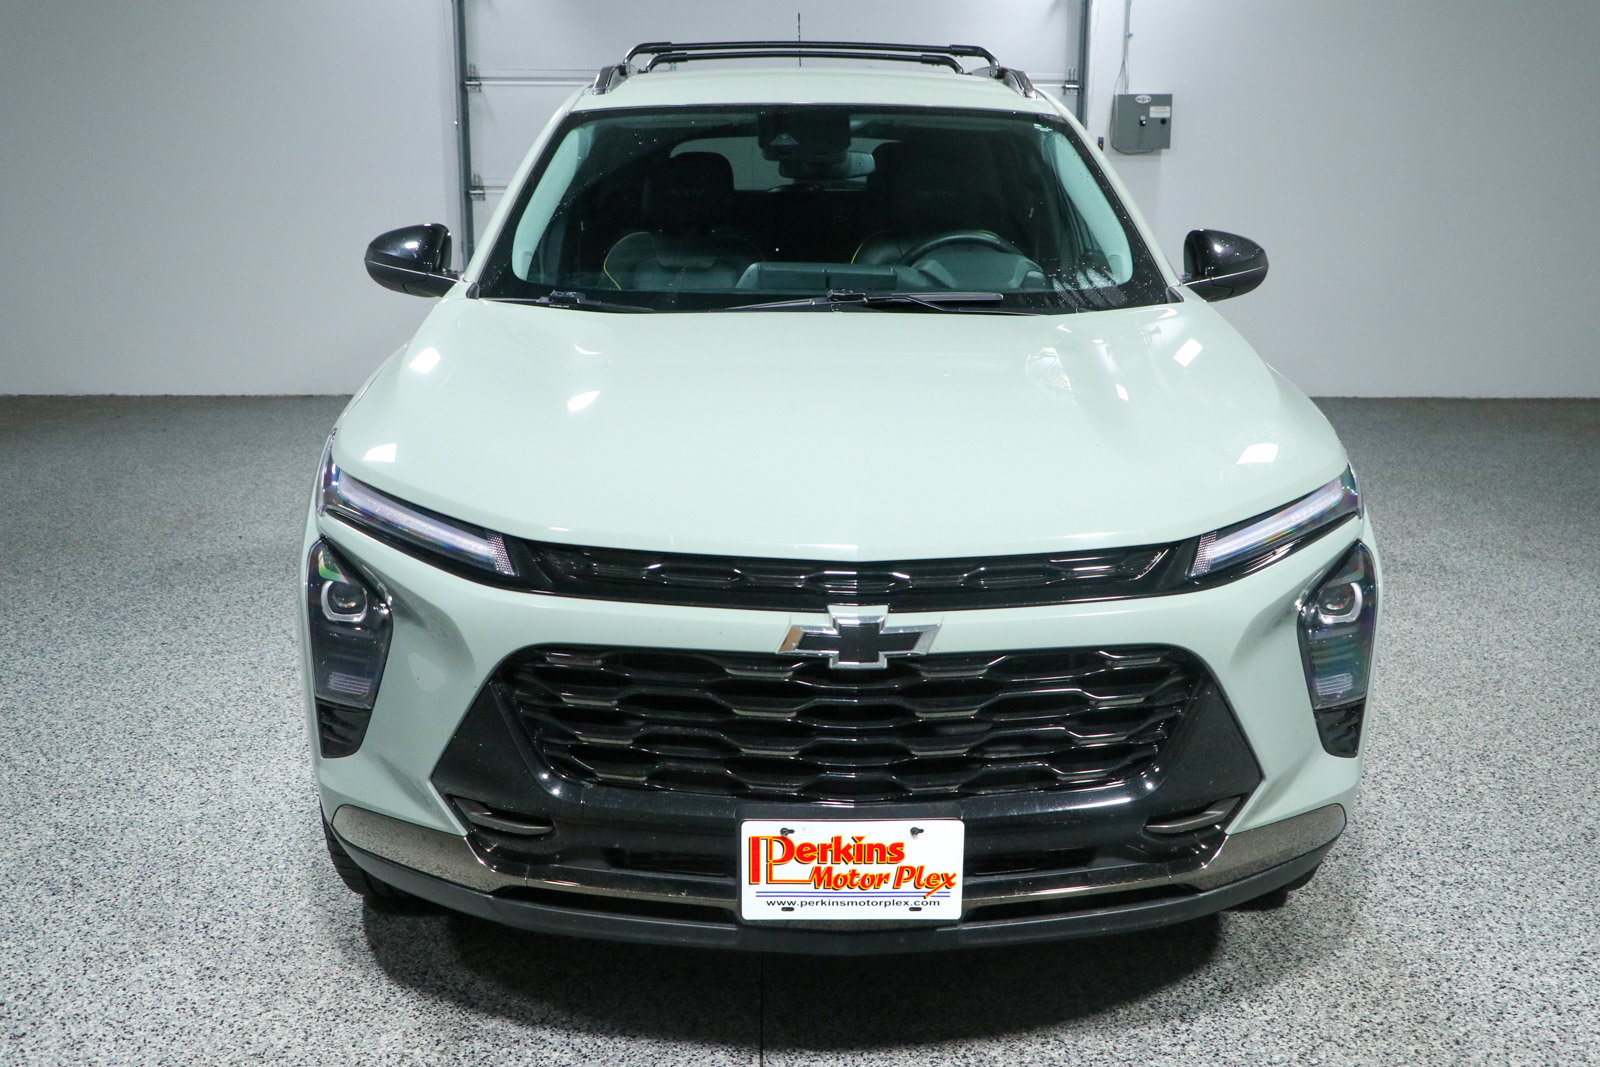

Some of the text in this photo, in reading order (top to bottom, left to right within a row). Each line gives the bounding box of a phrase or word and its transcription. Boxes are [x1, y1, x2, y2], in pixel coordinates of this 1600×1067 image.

[749, 835, 905, 884] Perkins
[810, 865, 956, 898] Motor Plex
[766, 898, 941, 908] www.perkinsmotorplex.com
